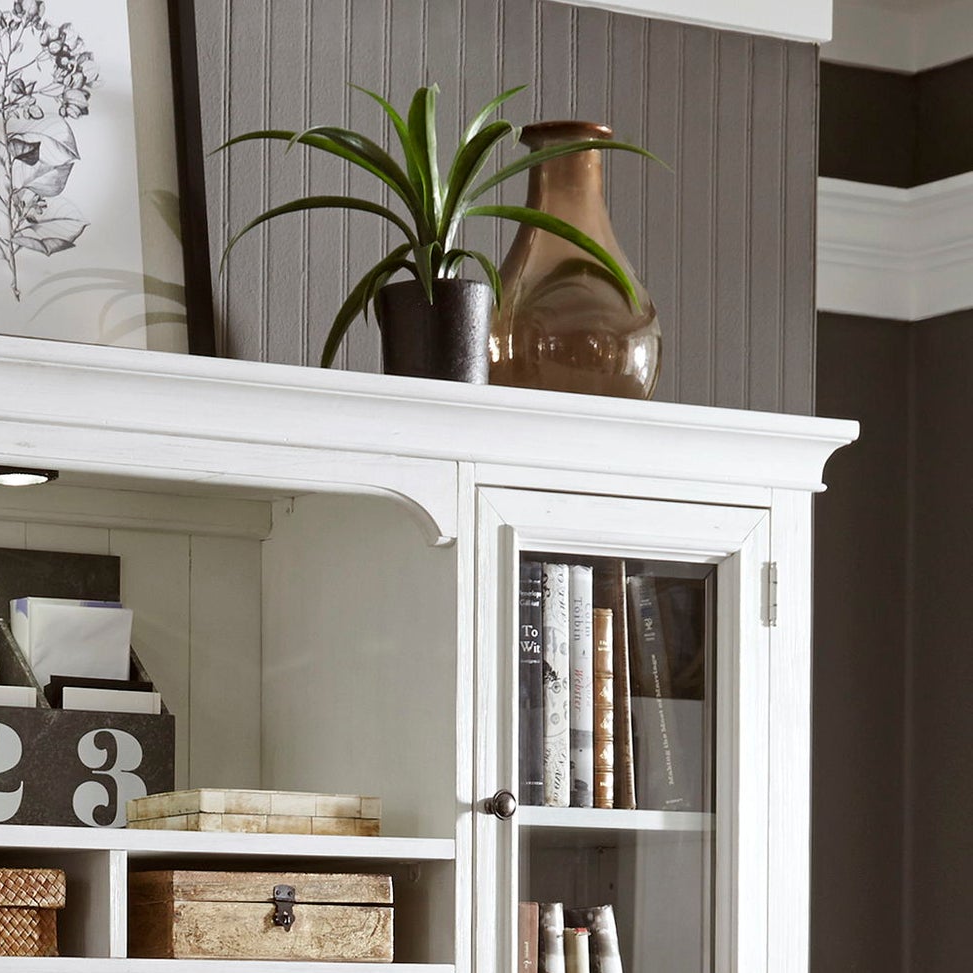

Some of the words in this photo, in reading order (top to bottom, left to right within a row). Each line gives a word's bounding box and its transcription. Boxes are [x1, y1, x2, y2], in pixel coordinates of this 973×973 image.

[521, 624, 539, 638] To
[520, 640, 541, 654] Wit
[574, 668, 584, 713] Webster
[72, 728, 148, 828] 3
